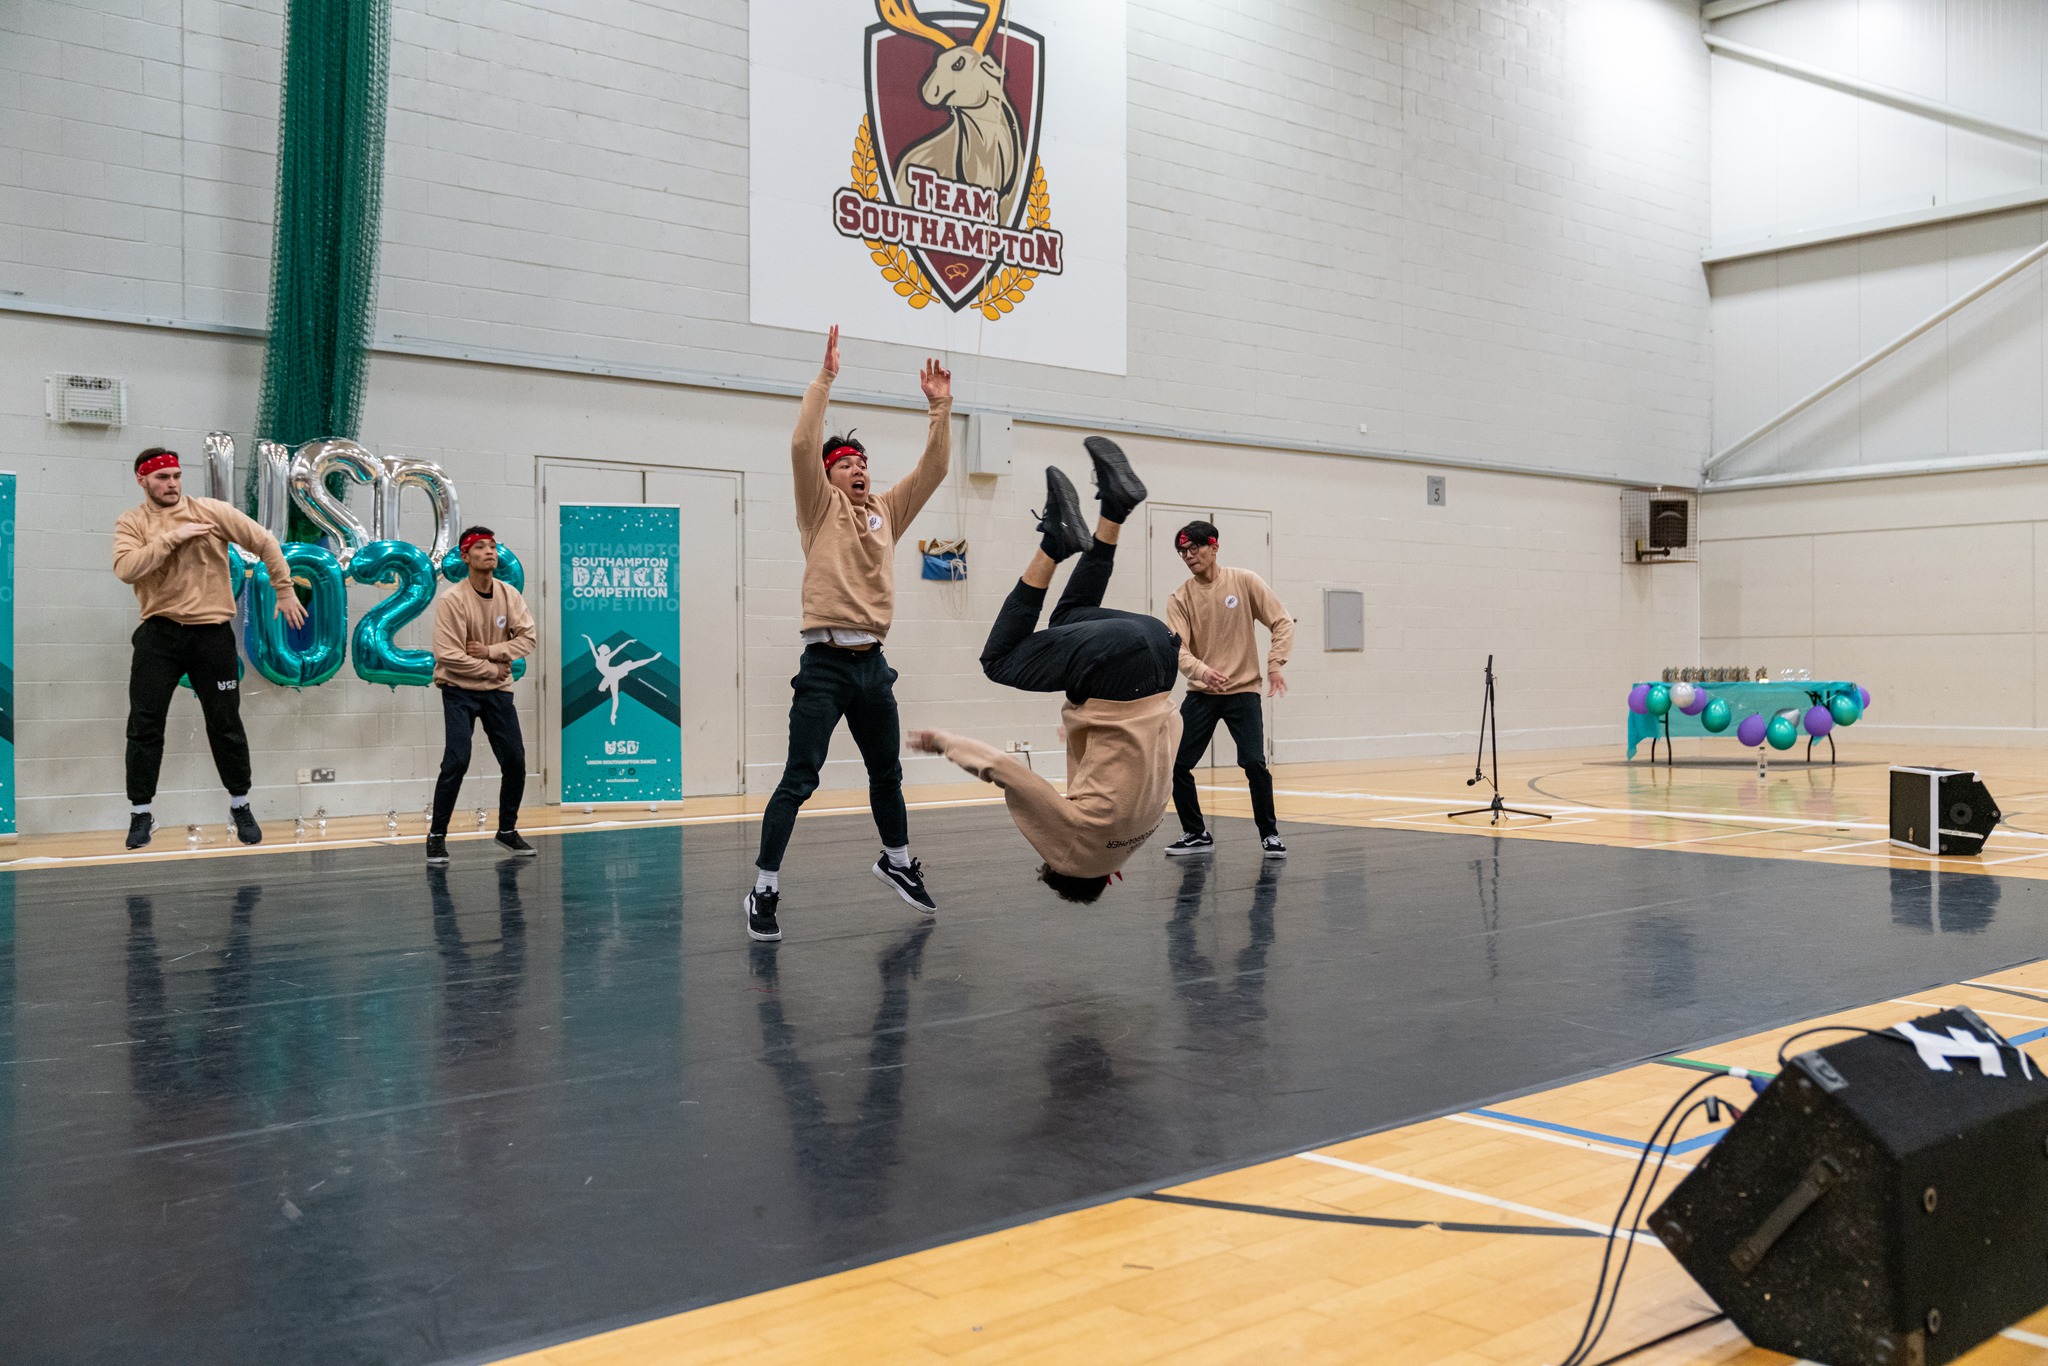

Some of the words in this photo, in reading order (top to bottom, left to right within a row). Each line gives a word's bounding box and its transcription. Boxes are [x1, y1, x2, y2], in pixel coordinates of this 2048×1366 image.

[911, 170, 997, 222] TEAM
[838, 194, 1060, 269] SOUTHAMPTON
[1433, 487, 1440, 502] 5
[571, 557, 669, 567] SOUTHAMPTON
[572, 567, 668, 587] DANCE
[572, 587, 668, 598] COMPETITION
[178, 540, 527, 691] 02
[604, 740, 640, 755] USD
